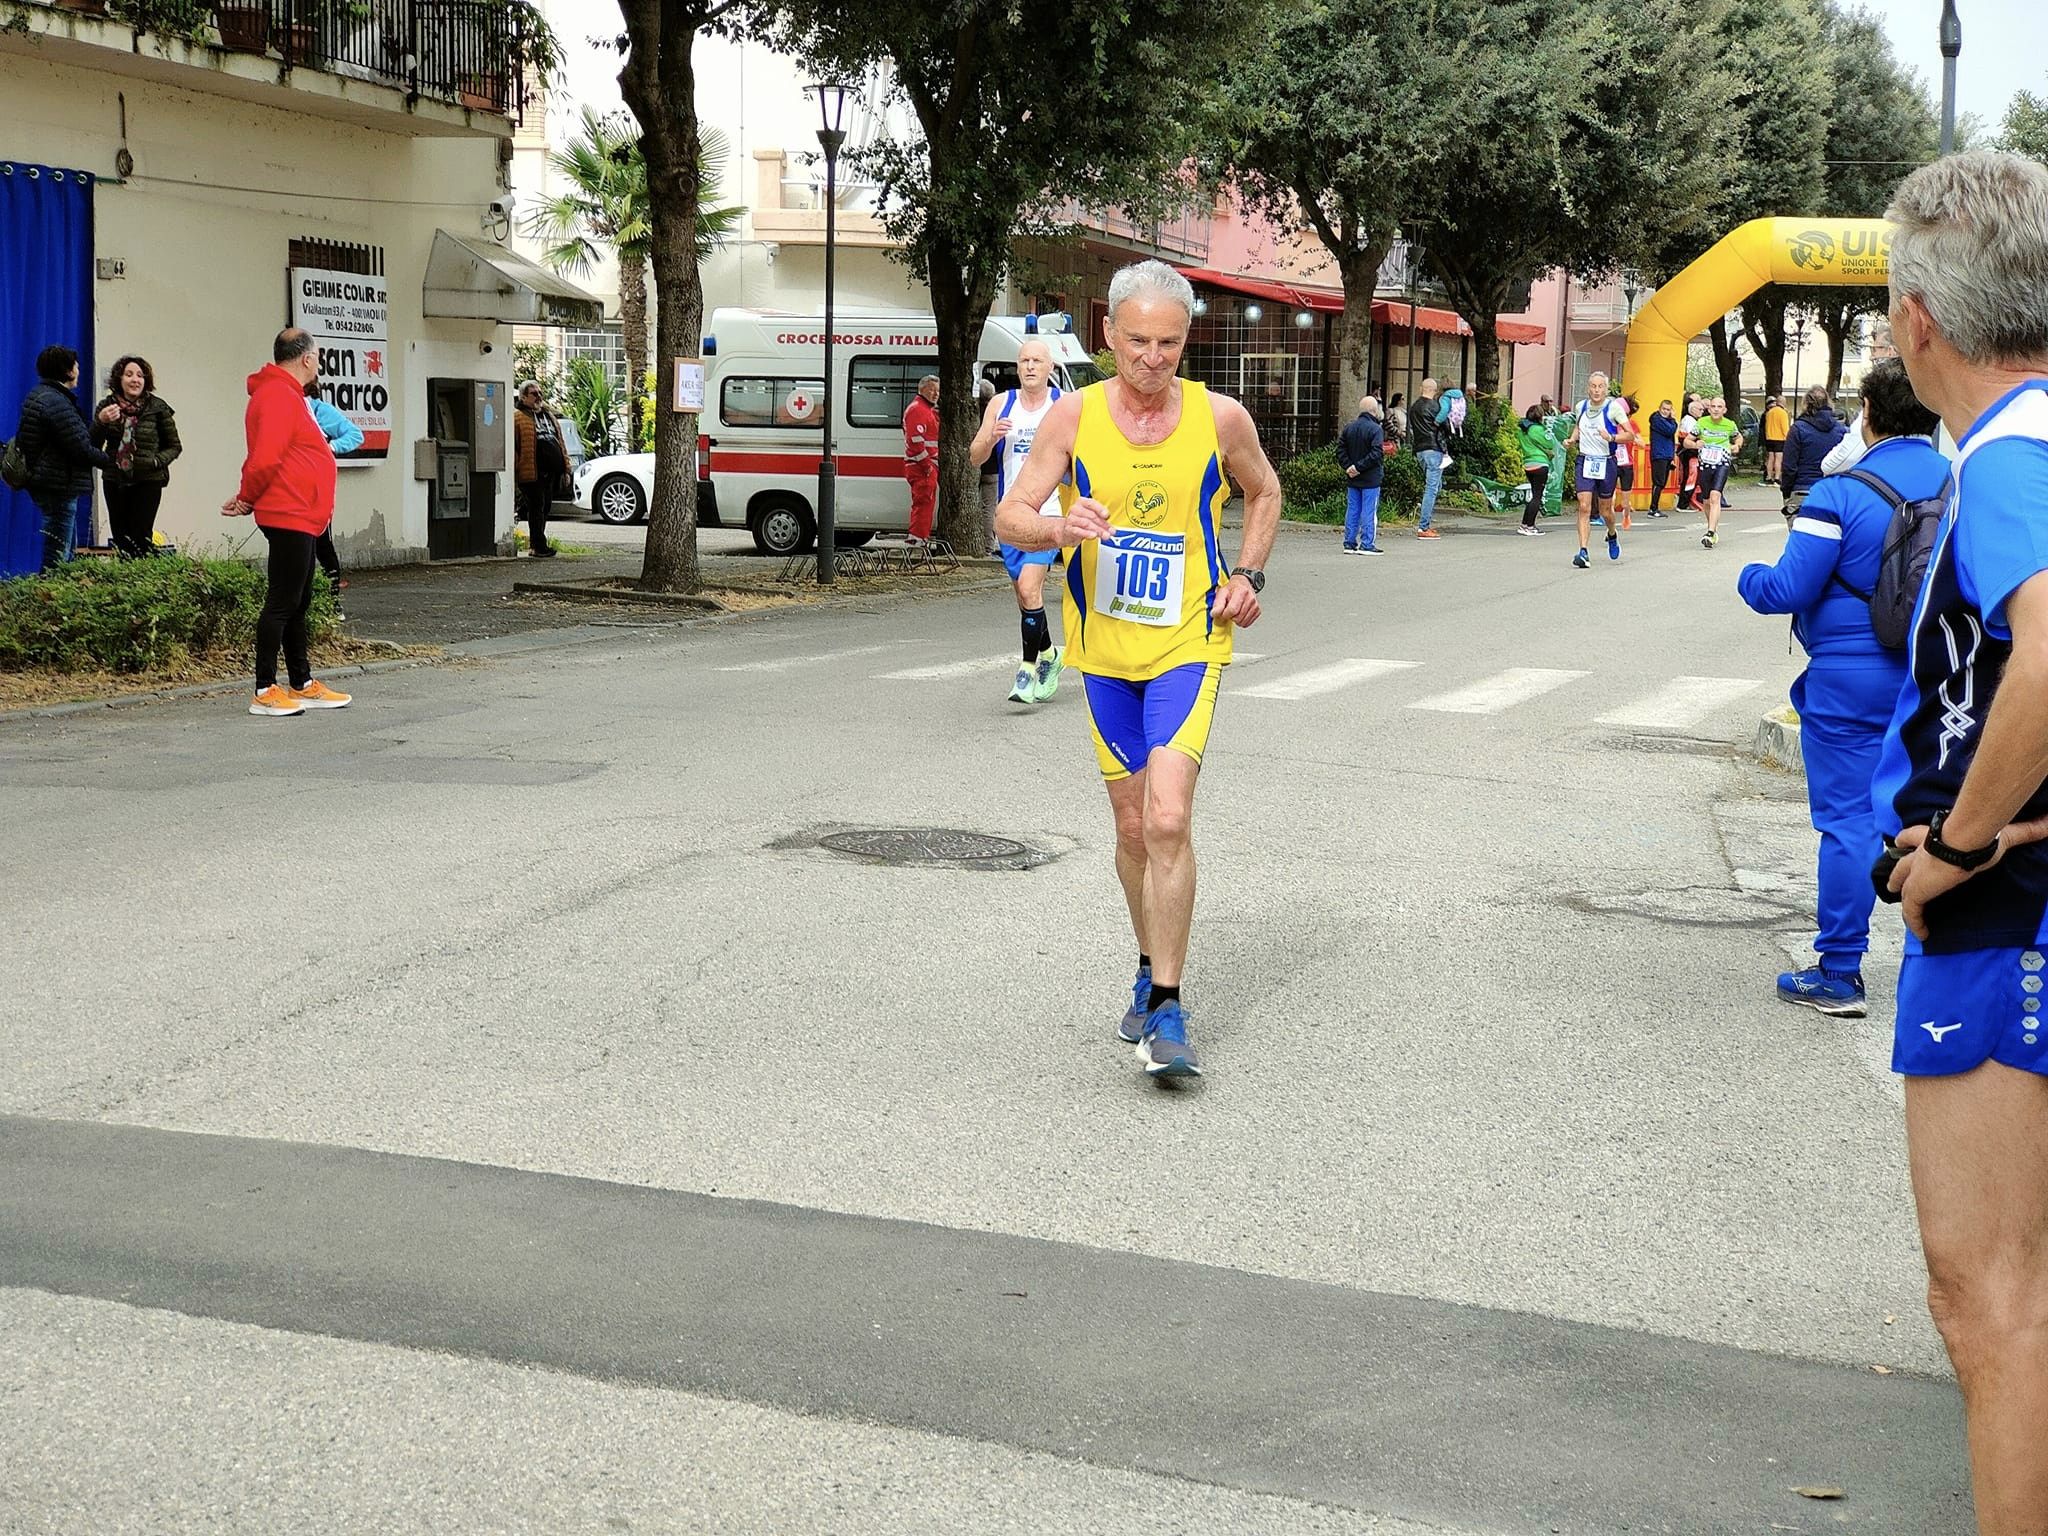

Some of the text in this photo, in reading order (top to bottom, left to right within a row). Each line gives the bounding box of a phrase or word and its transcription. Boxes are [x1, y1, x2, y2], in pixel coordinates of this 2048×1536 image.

[1842, 258, 1877, 267] UNIONE
[1842, 267, 1870, 275] SPORT
[777, 334, 826, 344] CROCE
[832, 334, 883, 345] ROSSA
[318, 347, 356, 377] san
[319, 382, 388, 412] marco
[1115, 552, 1170, 602] 103
